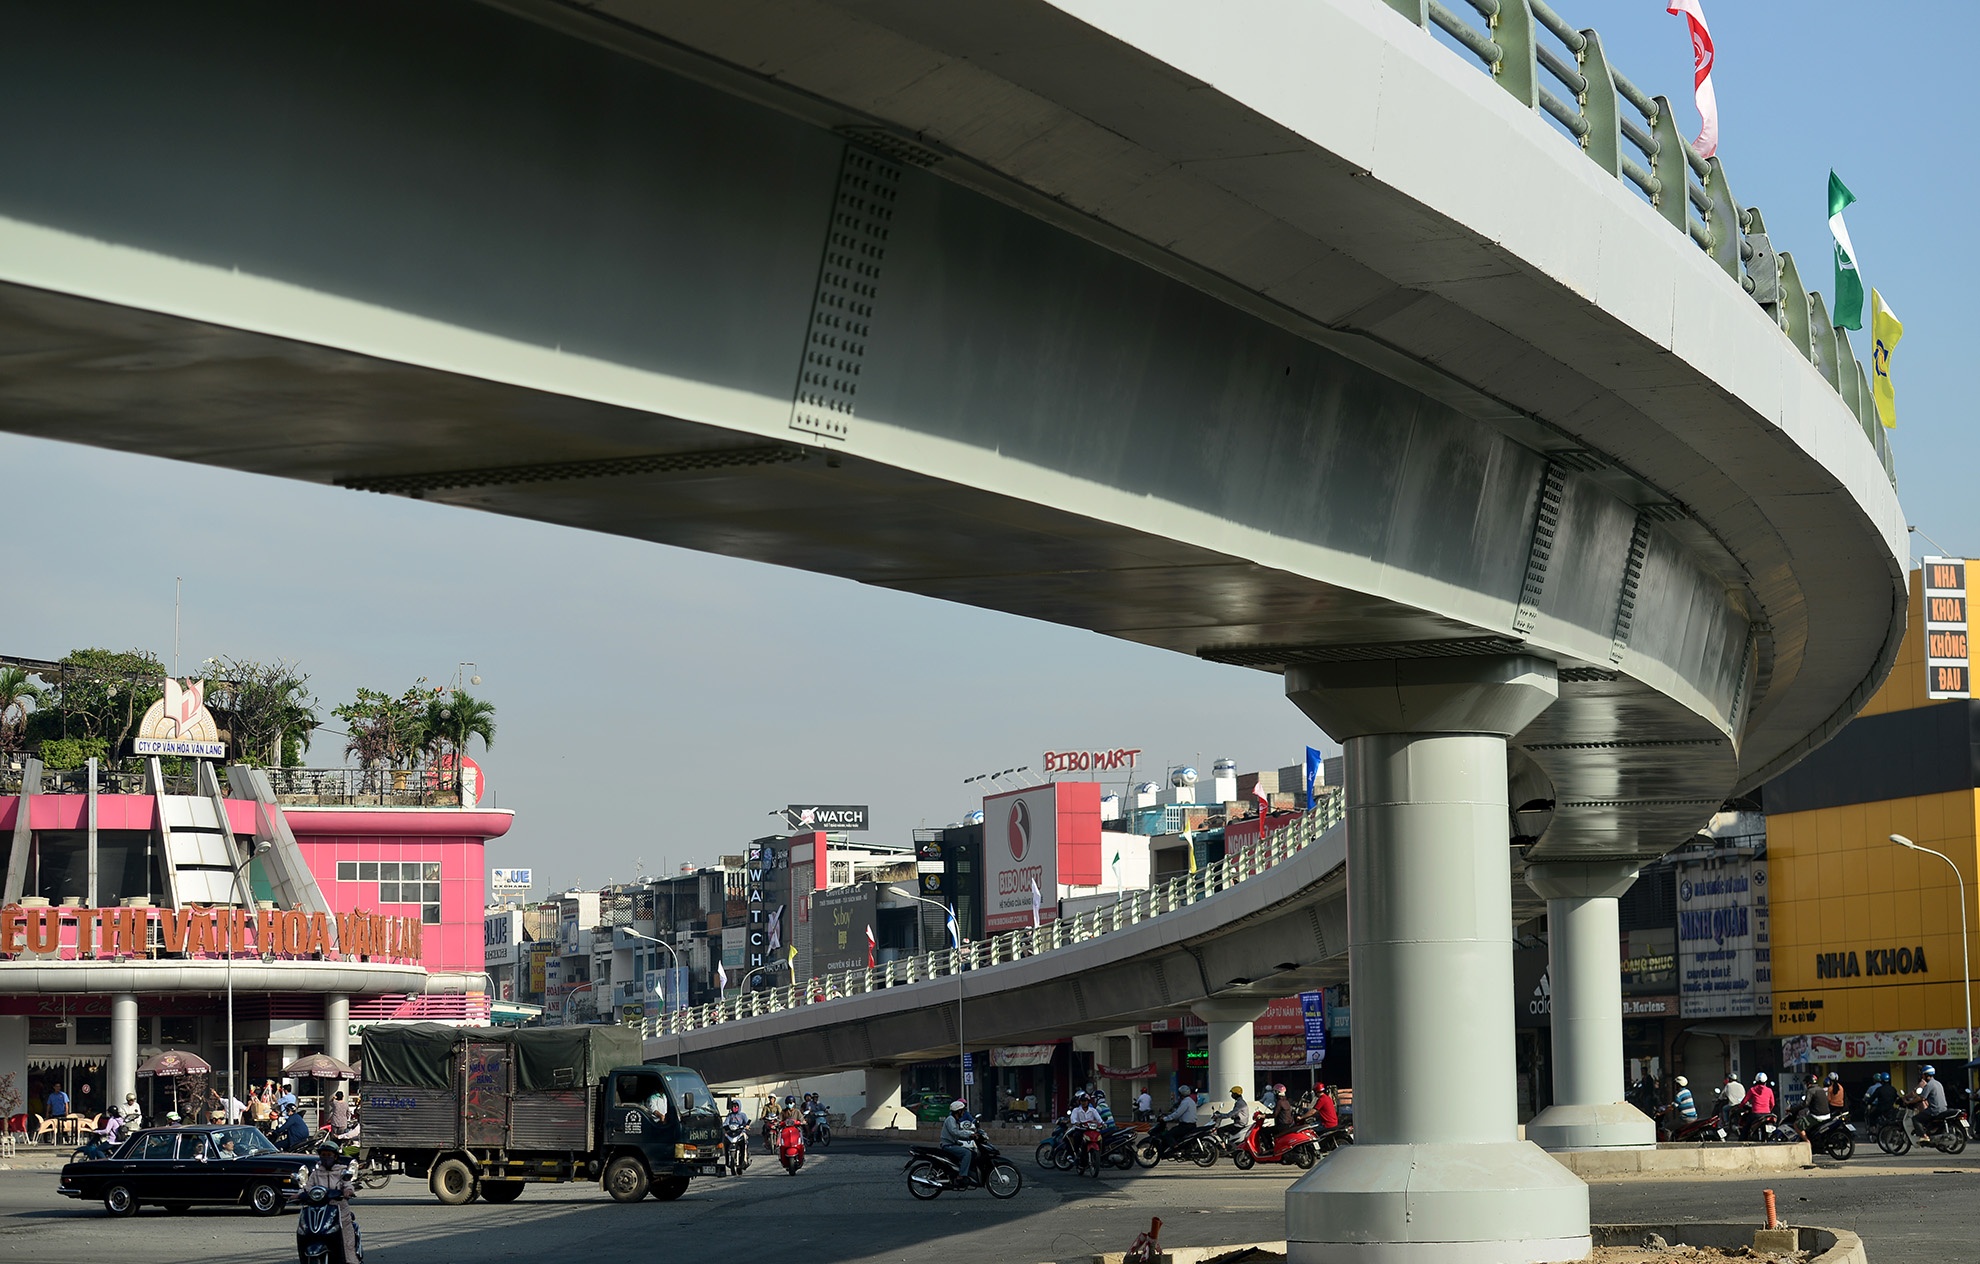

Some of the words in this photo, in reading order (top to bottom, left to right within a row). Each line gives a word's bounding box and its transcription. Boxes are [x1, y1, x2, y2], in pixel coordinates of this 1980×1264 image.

[1934, 565, 1957, 588] NHA
[1932, 598, 1962, 621] KHOA
[1929, 631, 1967, 658] KHÔNG
[1938, 667, 1961, 691] ĐAU
[138, 741, 151, 751] CTY
[152, 742, 161, 752] CP
[205, 745, 223, 755] LANG
[1044, 751, 1090, 772] BIBO
[1094, 748, 1142, 771] MART
[816, 810, 863, 823] WATCH
[999, 869, 1018, 895] BIBO
[1020, 865, 1042, 892] MART
[1680, 910, 1713, 941] MINH
[485, 948, 508, 960] XCHANGE
[1816, 951, 1861, 979] NHA
[1866, 946, 1928, 976] KHOA
[547, 1002, 560, 1012] ANH
[1758, 996, 1769, 1005] 04
